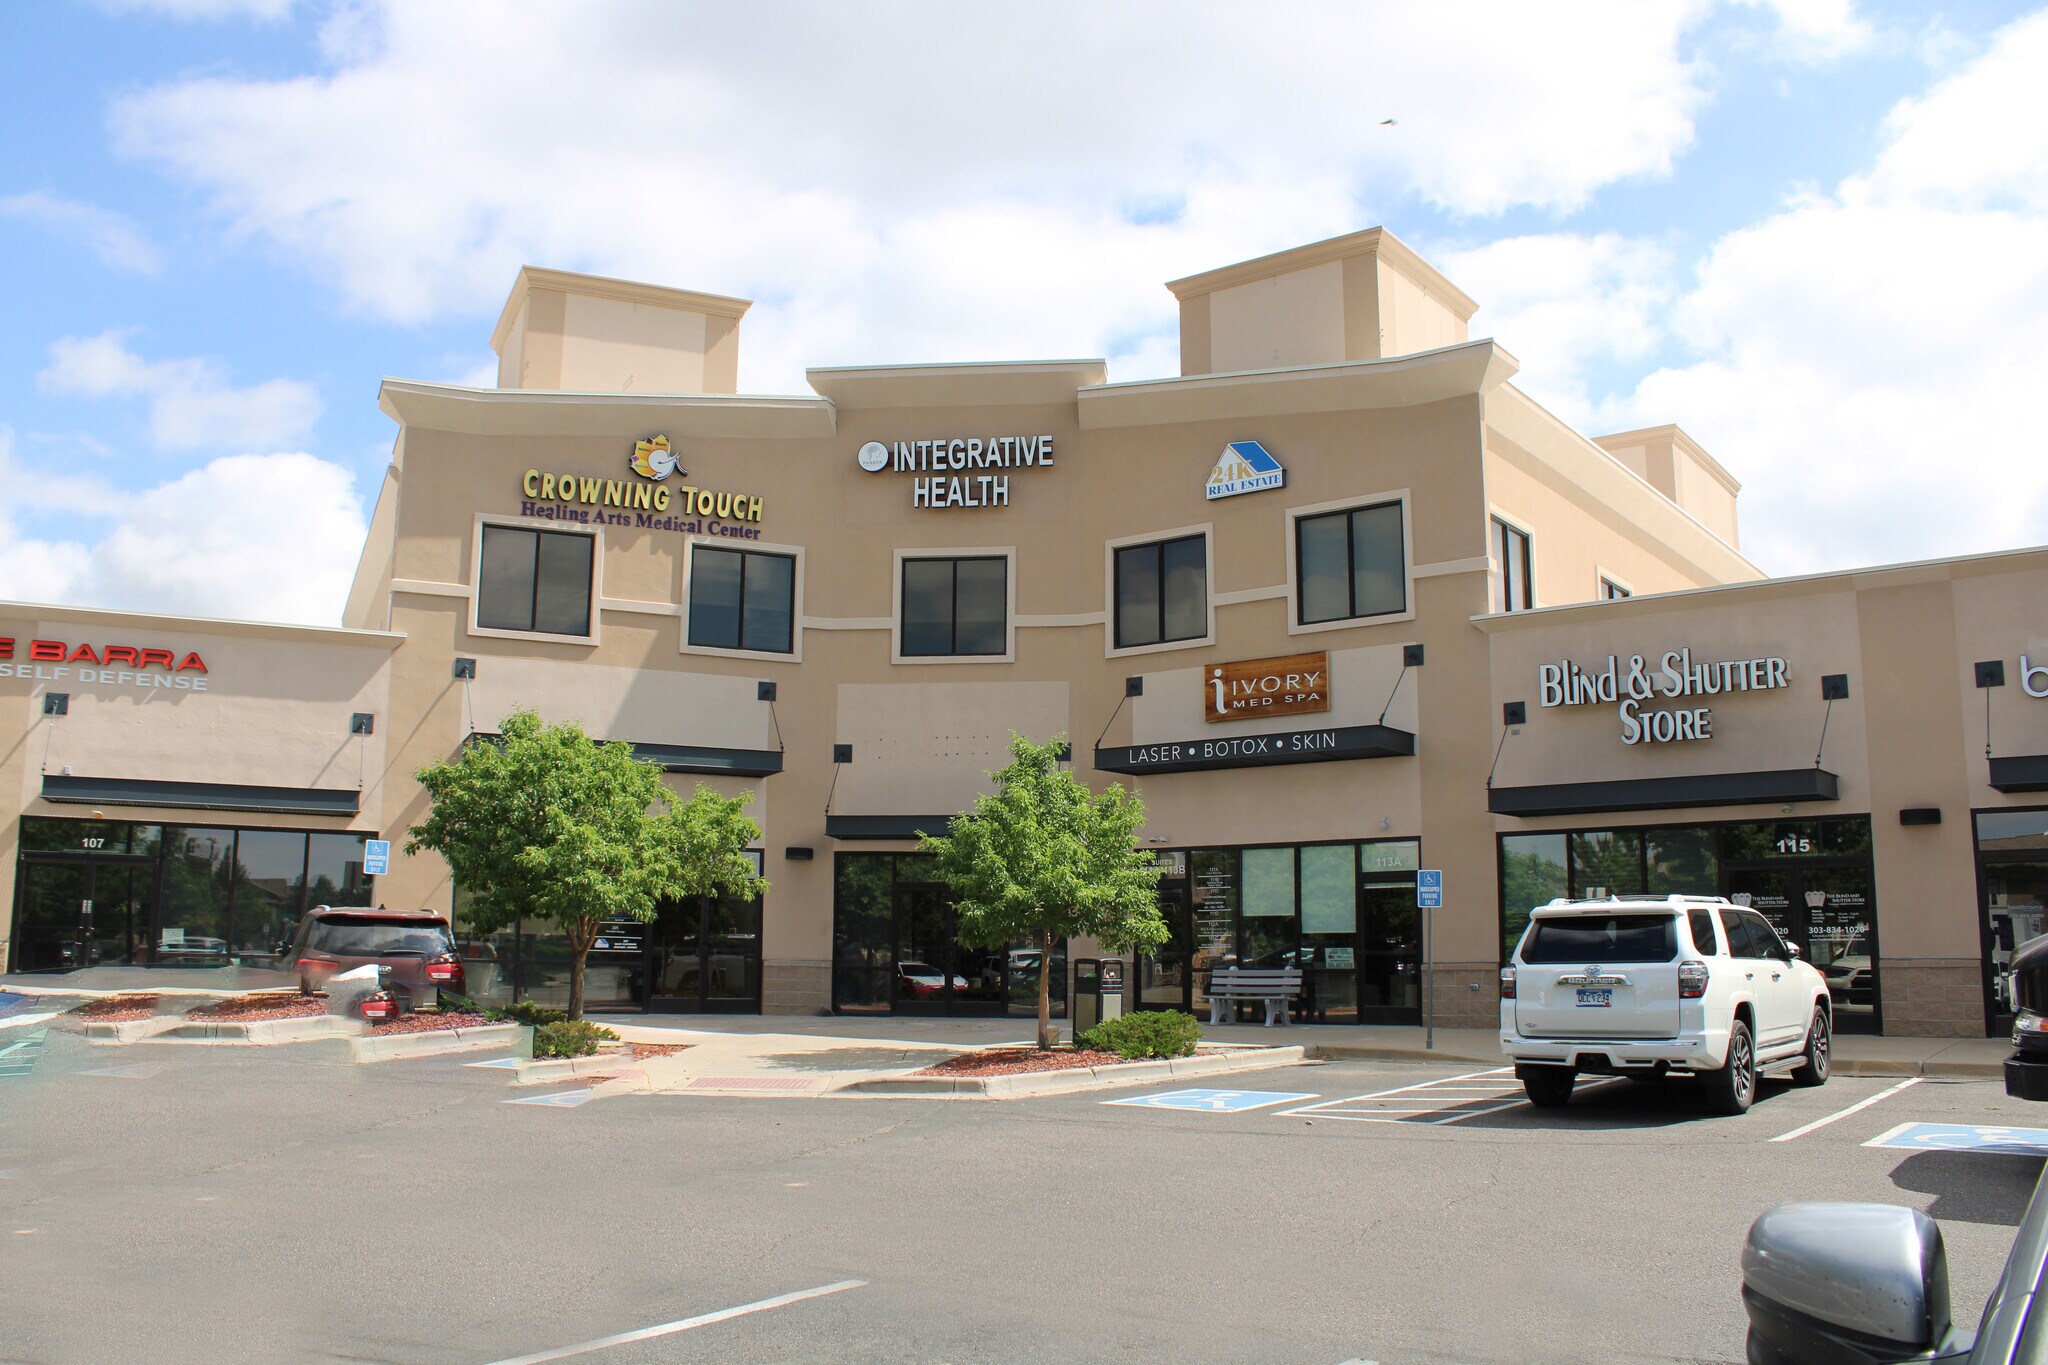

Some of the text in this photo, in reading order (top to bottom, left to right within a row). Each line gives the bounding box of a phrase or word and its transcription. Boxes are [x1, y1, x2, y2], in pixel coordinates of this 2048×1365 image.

[893, 435, 1054, 472] INTEGRATIVE
[1209, 474, 1280, 495] REAL ESTATE
[1211, 460, 1252, 483] 24K
[523, 468, 764, 522] CROWNING TOUCH
[913, 475, 1010, 508] HEALTH
[520, 501, 761, 540] Healing Arts Medical Center
[30, 639, 209, 673] BARRA
[0, 663, 209, 691] SELF DEFENSE
[1232, 671, 1321, 697] IVORY
[1627, 653, 1656, 700] &
[1233, 692, 1321, 708] MED SPA
[1619, 699, 1713, 745] STORE
[1129, 732, 1336, 764] LASER BOTOX SKIN
[82, 838, 105, 848] 107
[1776, 839, 1811, 853] 115
[1375, 856, 1402, 867] 113A
[1808, 926, 1865, 934] 303-834-1020
